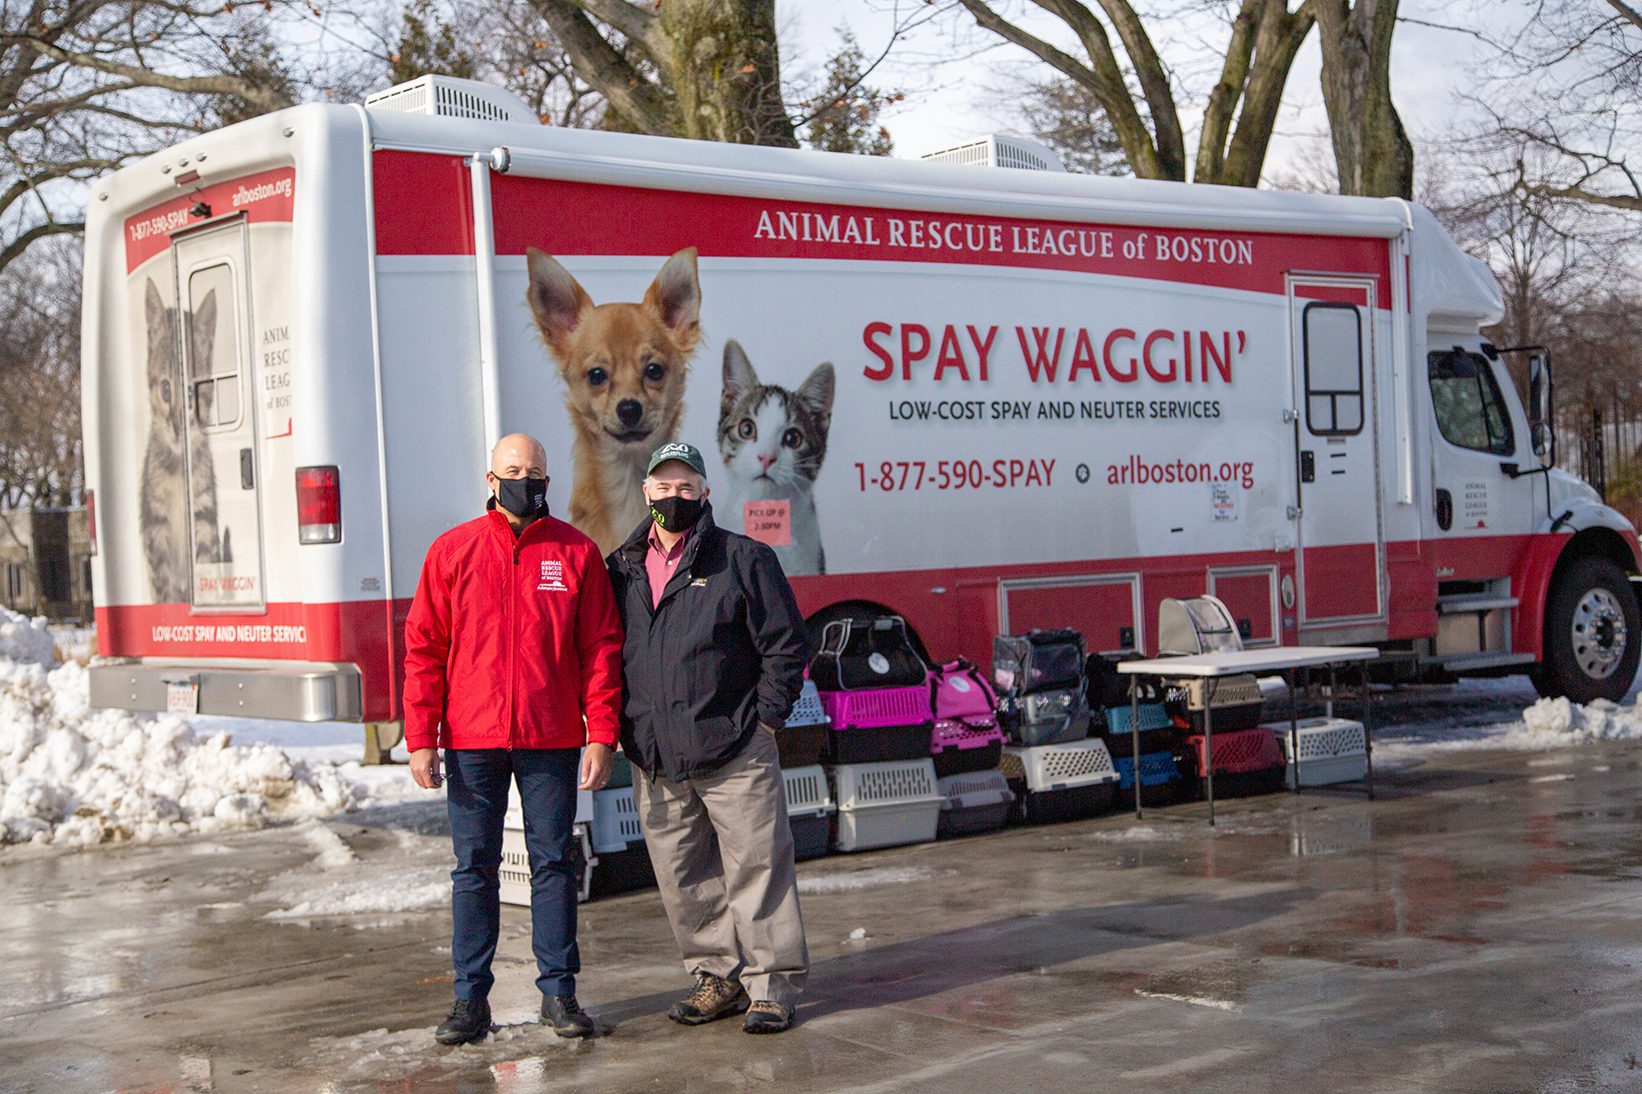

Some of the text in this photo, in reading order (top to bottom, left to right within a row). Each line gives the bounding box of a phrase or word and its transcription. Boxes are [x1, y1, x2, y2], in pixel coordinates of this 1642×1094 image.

[232, 177, 292, 207] arlboston.org
[129, 208, 189, 241] 1-877-590-SPAY
[754, 210, 1253, 265] ANIMAL RESCUE LEAGUE of BOSTON
[263, 325, 290, 344] ANIM
[264, 348, 290, 368] RESC
[863, 321, 1247, 384] SPAY WAGGIN'
[275, 395, 292, 409] BOS
[890, 400, 1221, 420] LOW-COST SPAY AND NEUTER SERVICES
[854, 454, 1254, 492] 1-877-590-SPAY arlboston.org
[765, 508, 776, 517] UP
[152, 625, 307, 643] LOW-COST SPAY AND NEUTER SERVIC
